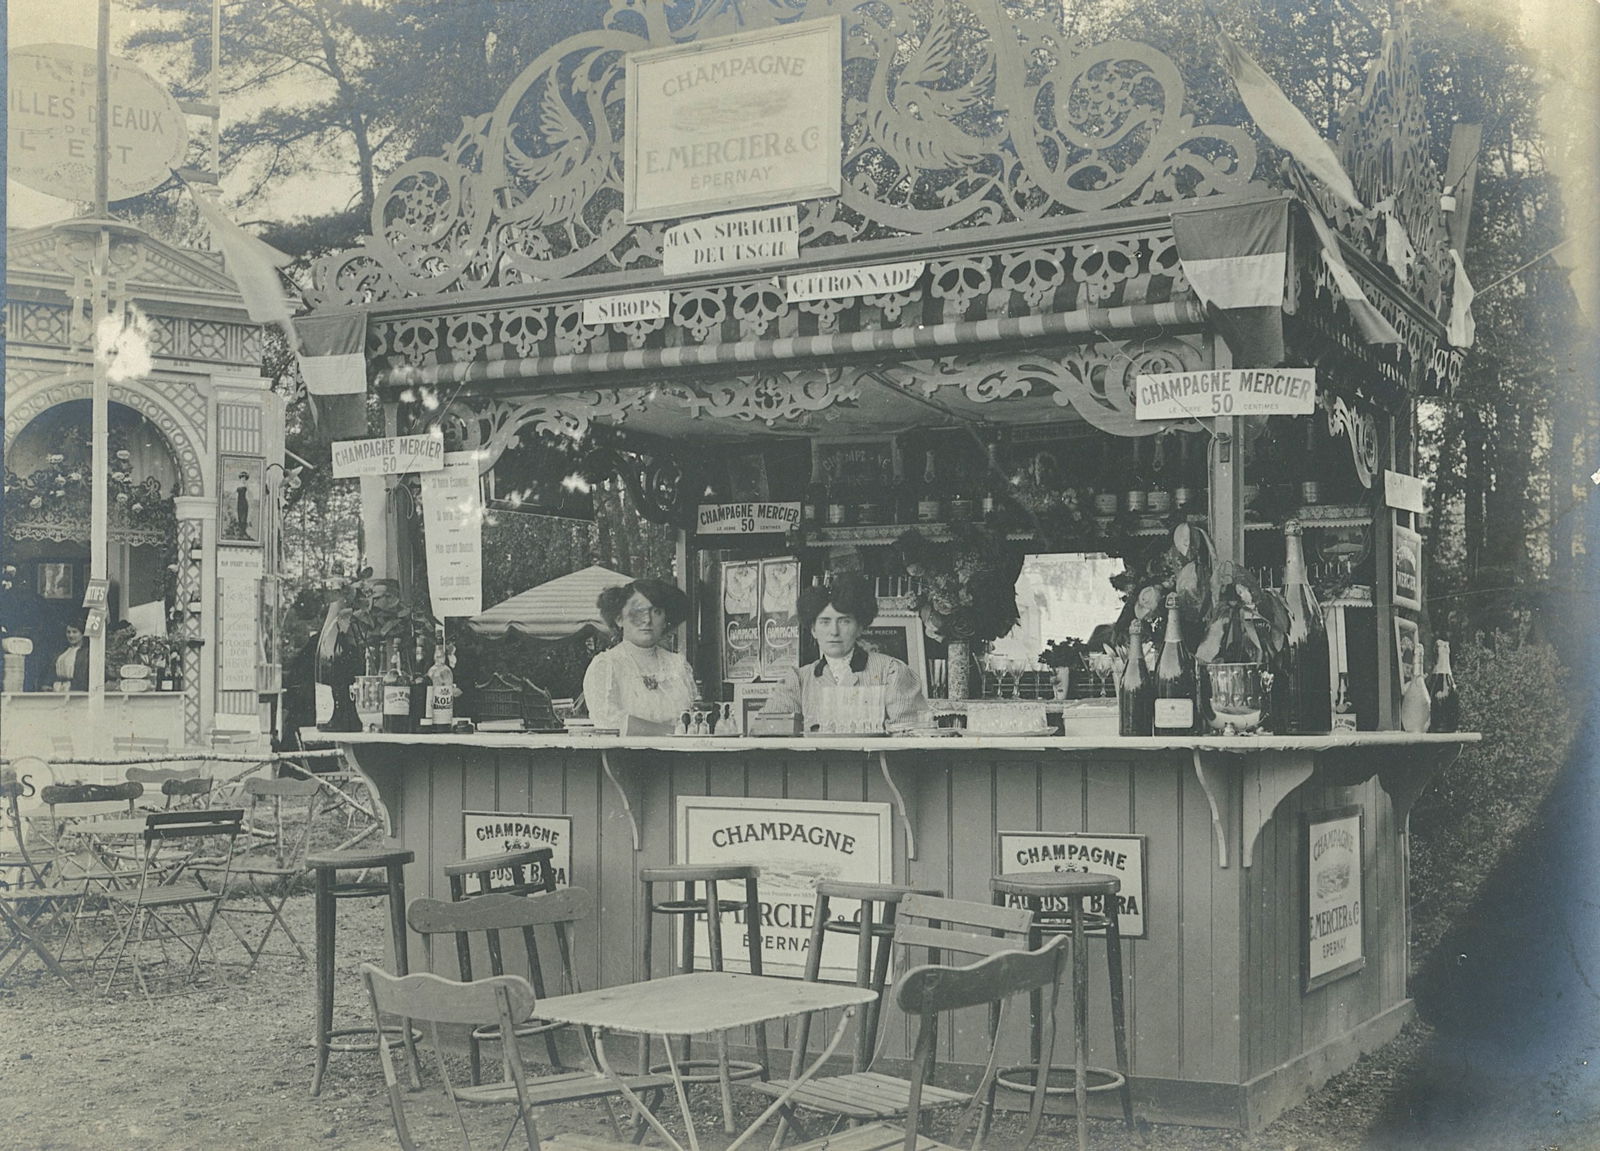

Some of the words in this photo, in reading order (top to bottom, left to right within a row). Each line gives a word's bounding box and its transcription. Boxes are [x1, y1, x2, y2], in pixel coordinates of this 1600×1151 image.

[661, 54, 807, 98] CHAMPAGNE
[785, 135, 797, 154] &
[666, 227, 702, 247] MAN
[714, 214, 796, 239] SPRICHT
[693, 241, 786, 265] DEUTSCH
[598, 300, 662, 318] SIROPS
[1140, 371, 1232, 406] CHAMPAGNE
[1239, 371, 1312, 400] MERCIER
[1210, 393, 1234, 414] 50
[334, 439, 396, 467] CHAMPAGNE
[399, 438, 442, 460] MERCIER
[382, 456, 397, 473] 50
[700, 504, 753, 525] CHAMPAGNE
[757, 504, 799, 522] MERCIER
[741, 519, 755, 532] 50
[476, 822, 560, 846] CHAMPAGNE
[712, 822, 856, 855] CHAMPAGNE
[1016, 844, 1128, 871] CHAMPAGNE
